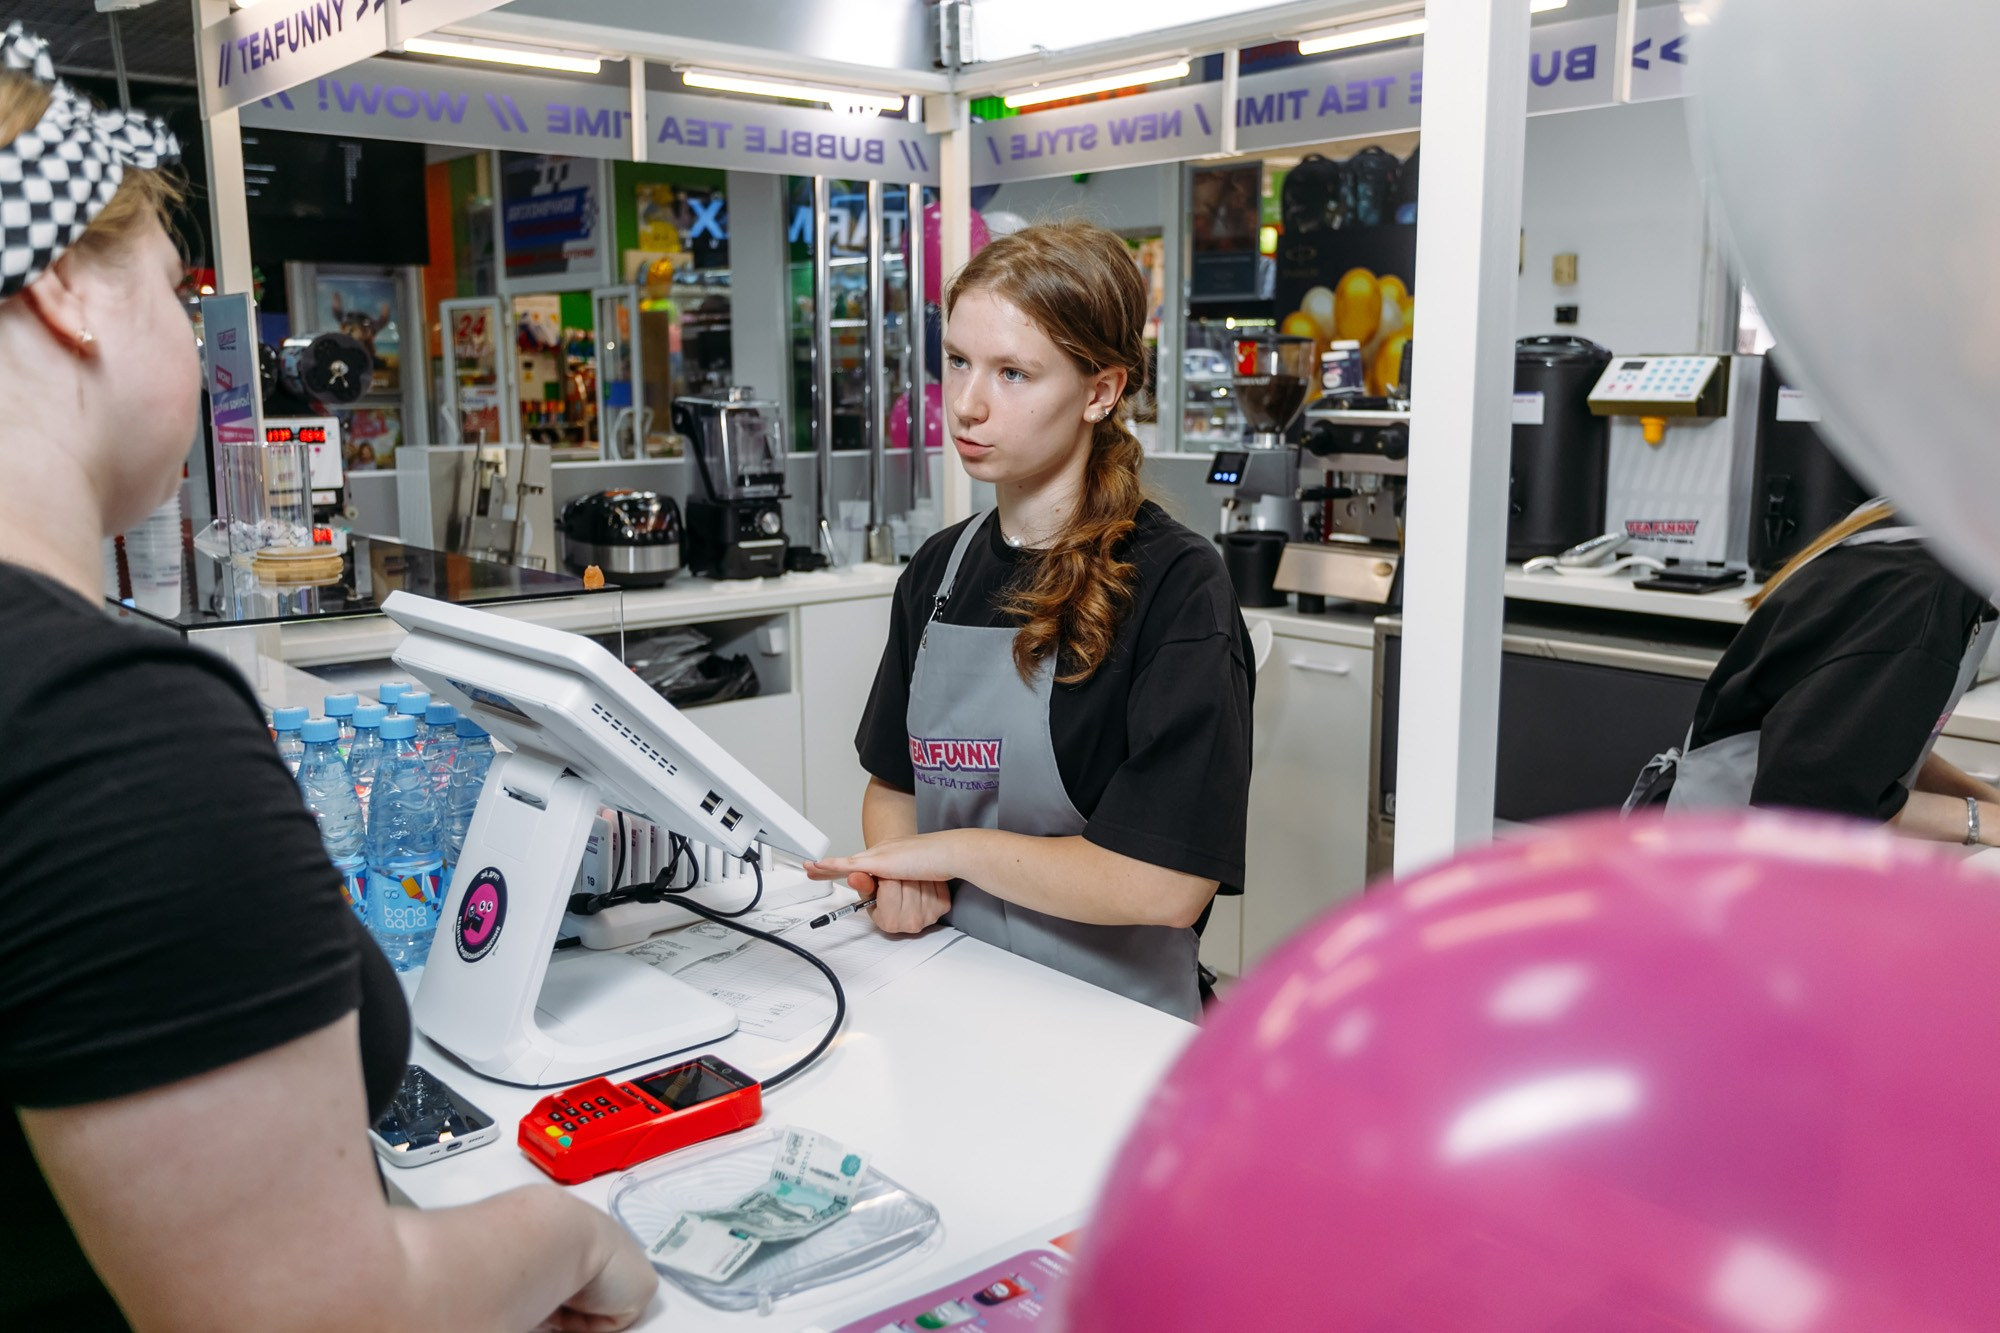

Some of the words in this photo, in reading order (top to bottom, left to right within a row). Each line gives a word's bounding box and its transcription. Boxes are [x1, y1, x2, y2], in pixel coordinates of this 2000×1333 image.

[237, 0, 344, 75] TEAFUNNY
[1652, 520, 1697, 537] FUNNY
[928, 742, 998, 768] FUNNY
[937, 776, 957, 790] TEA
[384, 916, 427, 932] aqua
